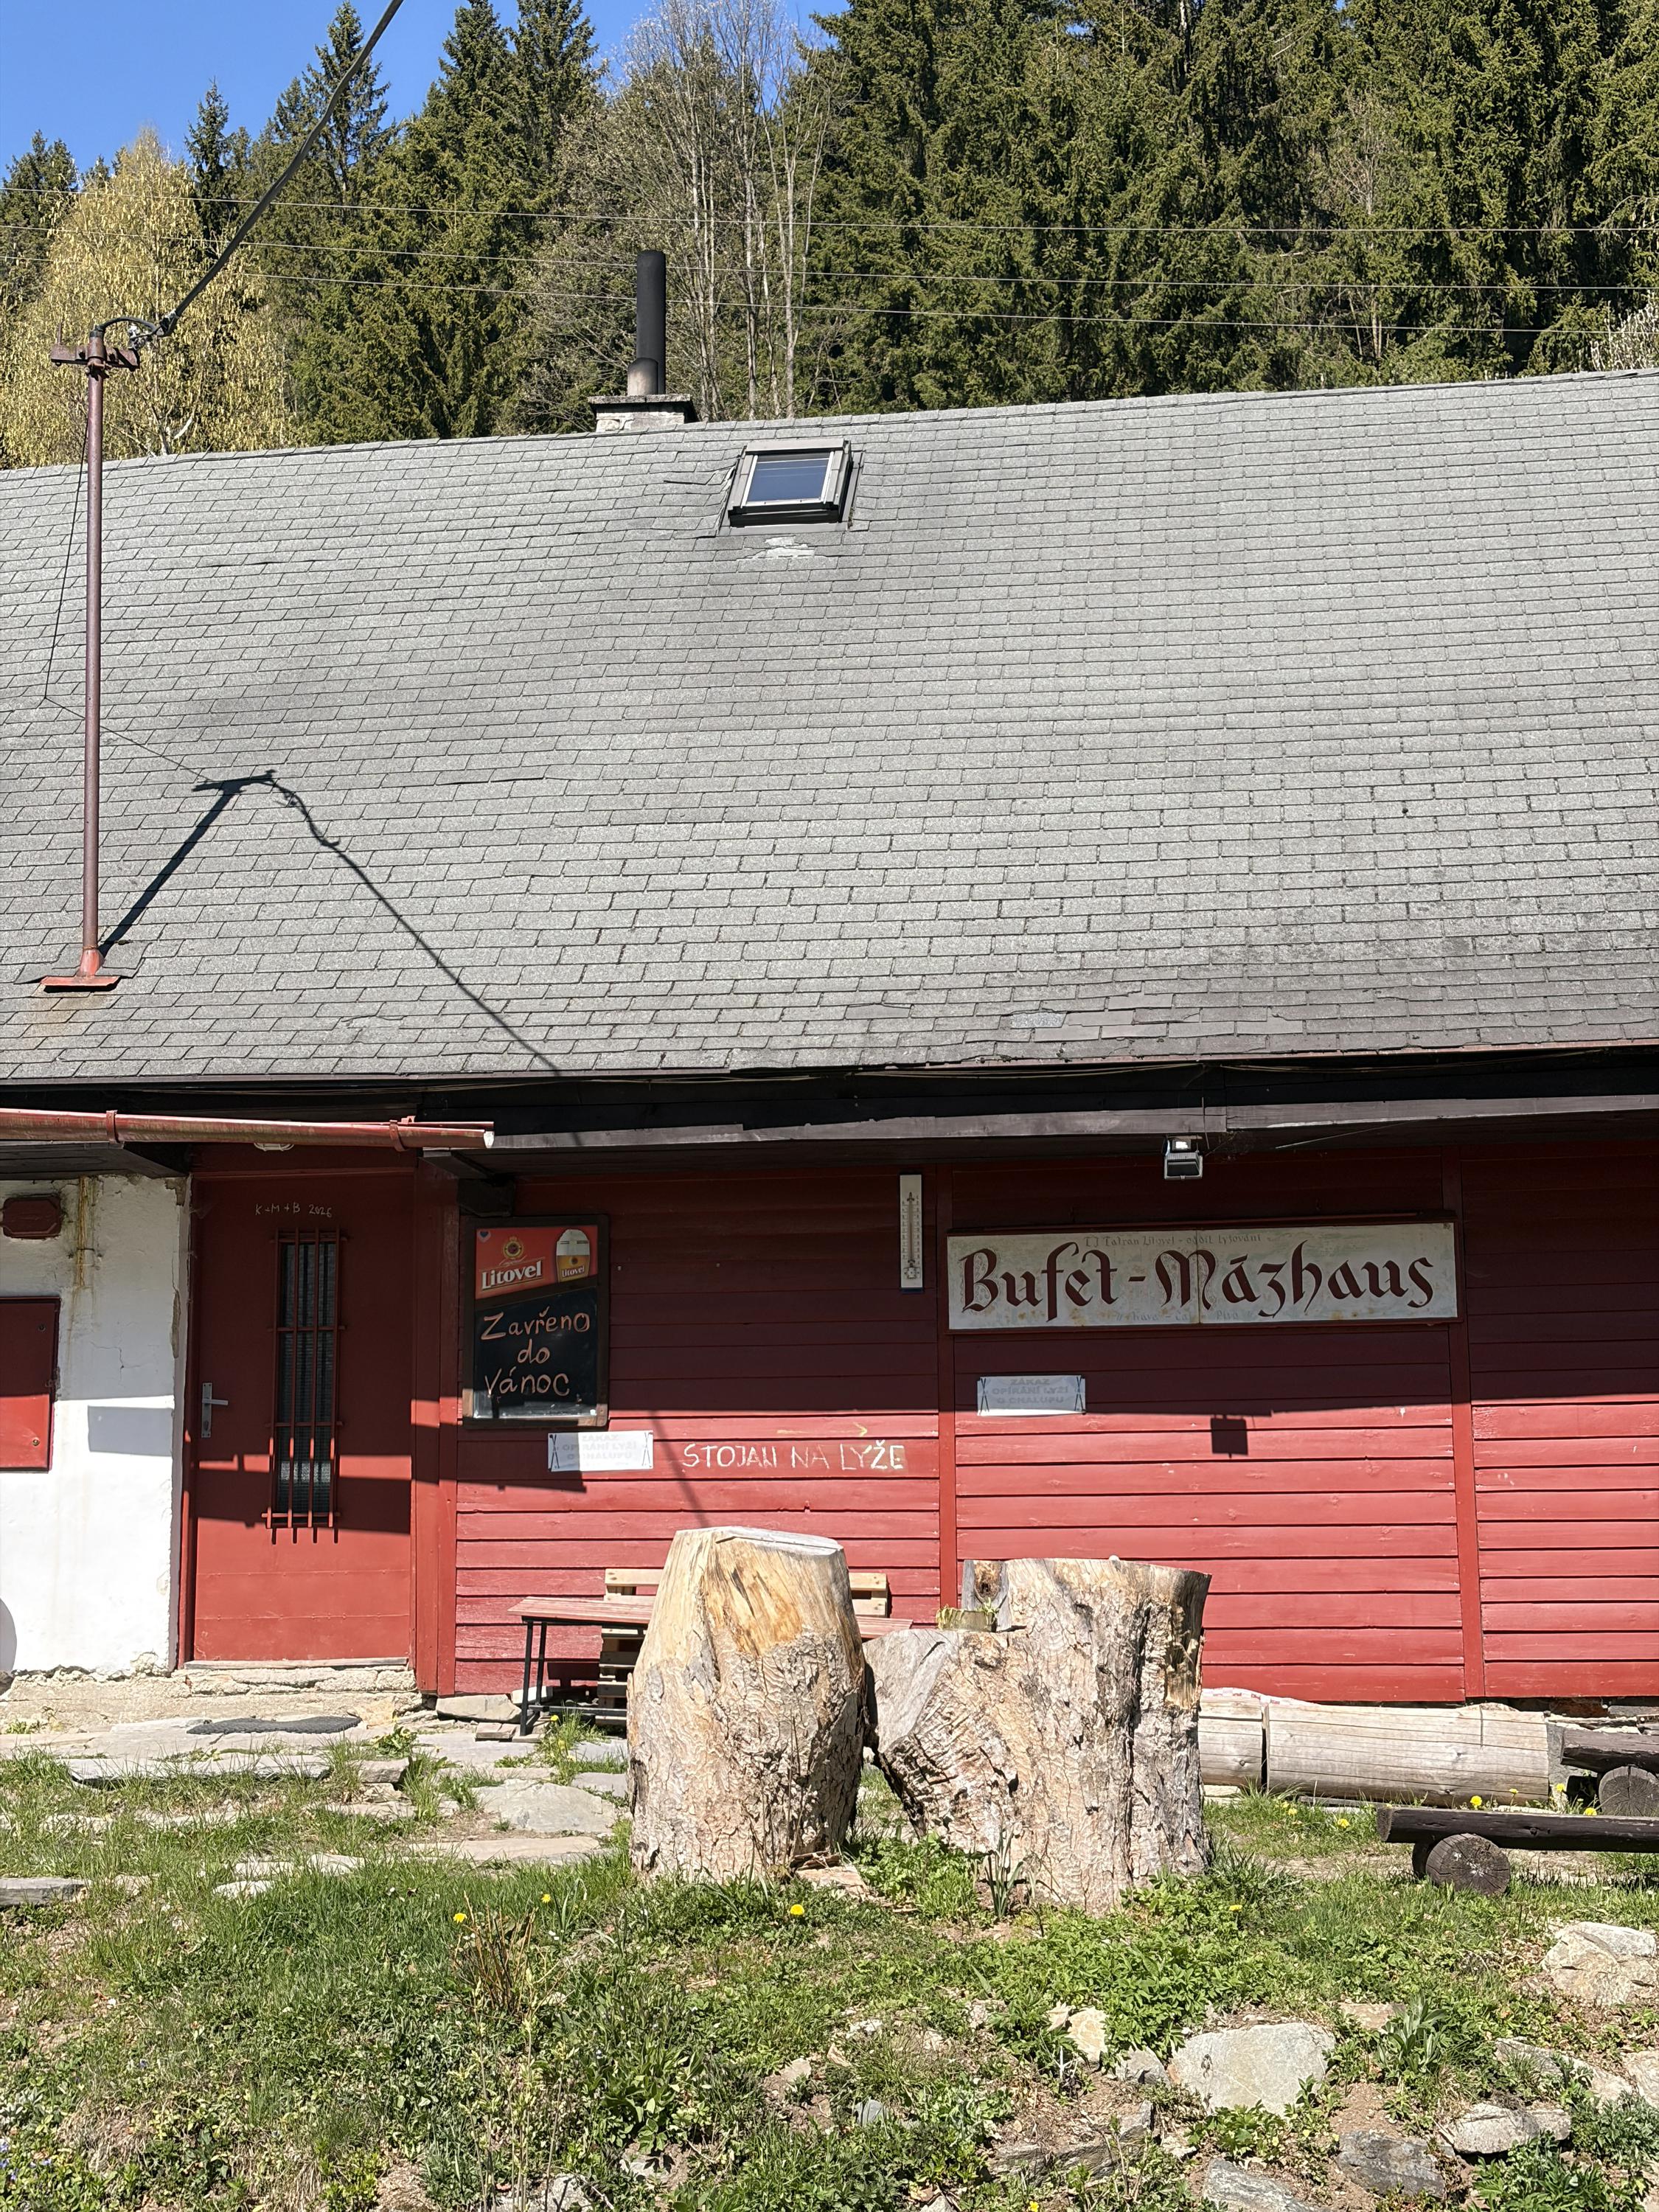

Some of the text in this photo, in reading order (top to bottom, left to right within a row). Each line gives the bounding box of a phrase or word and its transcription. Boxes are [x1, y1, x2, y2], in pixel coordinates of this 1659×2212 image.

[1102, 1235, 1140, 1246] Tatran
[481, 1260, 543, 1290] Litovel
[562, 1265, 585, 1278] Litovel
[481, 1306, 590, 1340] Zavřeno
[517, 1338, 551, 1364] do
[791, 1444, 830, 1470] NA
[840, 1439, 905, 1471] LYŽE
